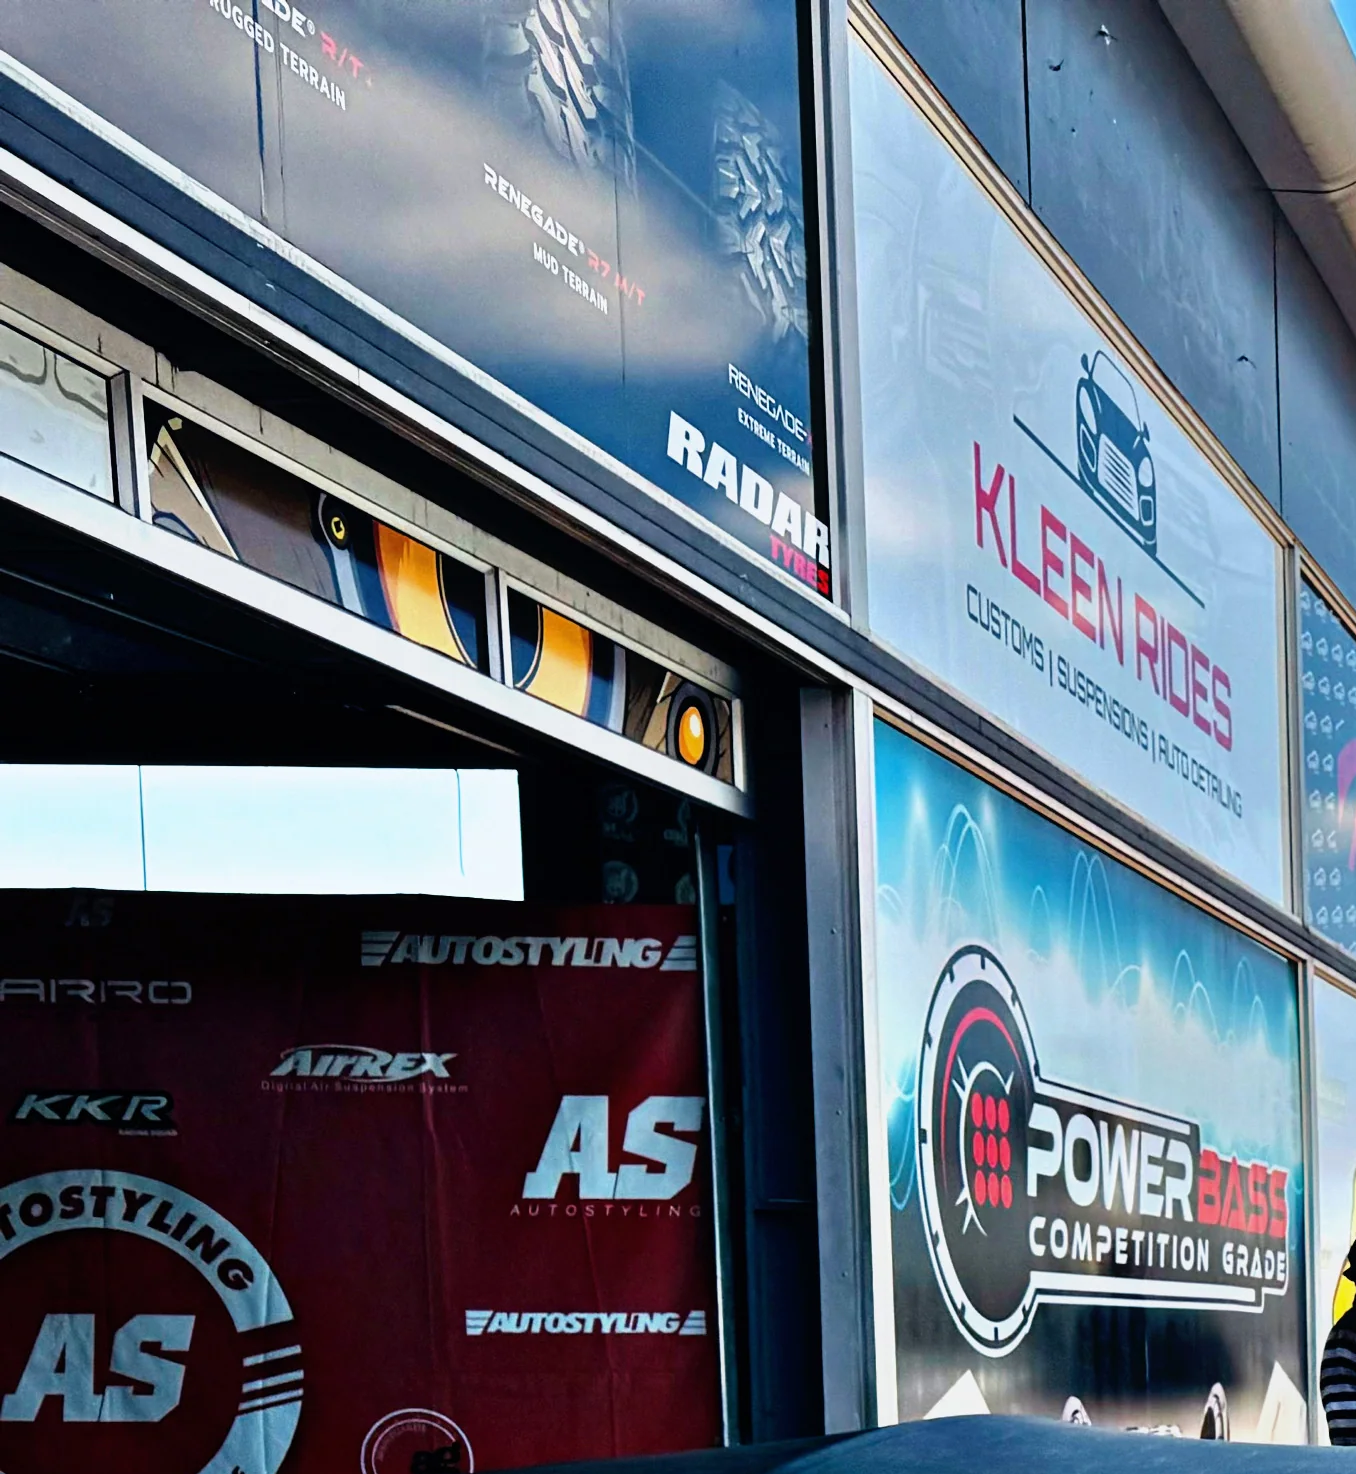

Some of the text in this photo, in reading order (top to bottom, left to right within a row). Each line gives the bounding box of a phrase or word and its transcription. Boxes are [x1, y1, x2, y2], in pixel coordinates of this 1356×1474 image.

[280, 42, 346, 111] TERRAIN
[533, 242, 608, 315] MUD TERRAIN
[738, 407, 811, 477] EXTREME TERRAIN
[667, 410, 829, 569] RADAR
[770, 535, 829, 596] TYRES
[974, 441, 1232, 752] KLEEN RIDES
[966, 584, 1243, 819] CUSTOMS SUSPENSIONS AUTO DETAILING
[15, 1094, 168, 1121] KKR
[522, 1095, 707, 1200] AS
[510, 1204, 702, 1217] AUTOSTYLING
[1029, 1216, 1287, 1282] COMPETITION GRADE
[0, 1313, 196, 1422] AS
